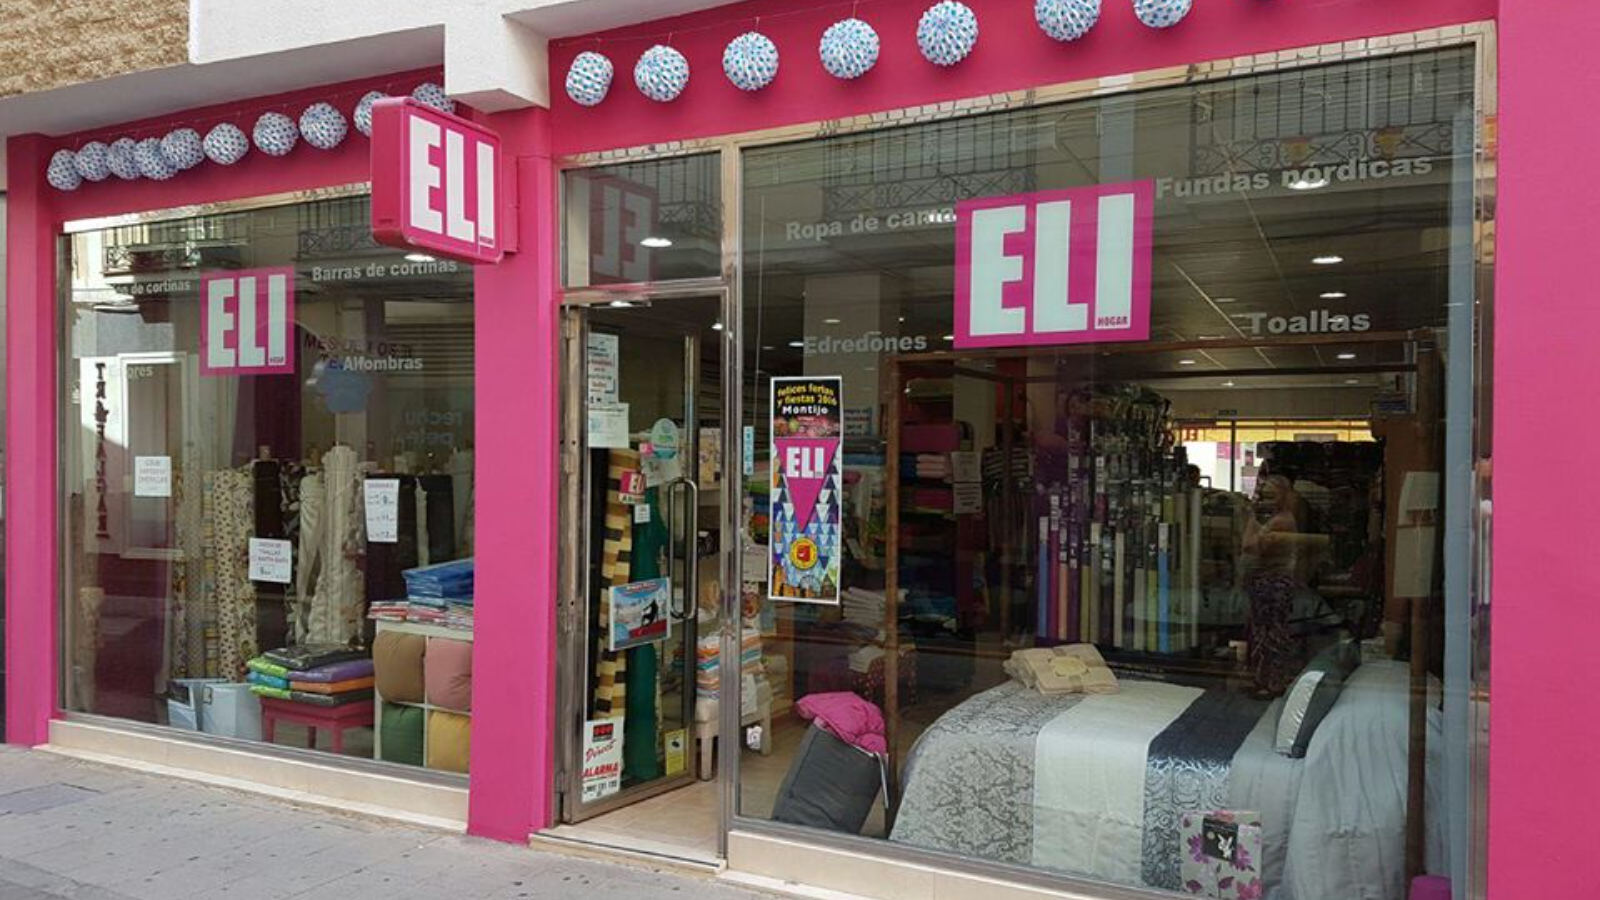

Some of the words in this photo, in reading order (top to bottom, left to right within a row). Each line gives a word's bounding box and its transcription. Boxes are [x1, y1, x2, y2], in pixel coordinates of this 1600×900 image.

[410, 115, 495, 248] ELI
[1156, 171, 1270, 198] Fundas
[1281, 157, 1433, 188] nórdicas
[786, 219, 842, 241] Ropa
[851, 214, 879, 232] de
[312, 265, 361, 282] Barras
[366, 263, 385, 278] de
[390, 258, 458, 276] cortinas
[969, 193, 1134, 336] ELI
[131, 282, 145, 294] de
[146, 279, 191, 294] cortinas
[208, 275, 286, 368] ELI
[1097, 316, 1128, 327] HOGAR
[1250, 310, 1371, 334] Toallas
[803, 333, 927, 355] Edredones
[343, 355, 424, 371] Alfombras
[782, 404, 829, 416] Montijo
[786, 446, 824, 478] ELI
